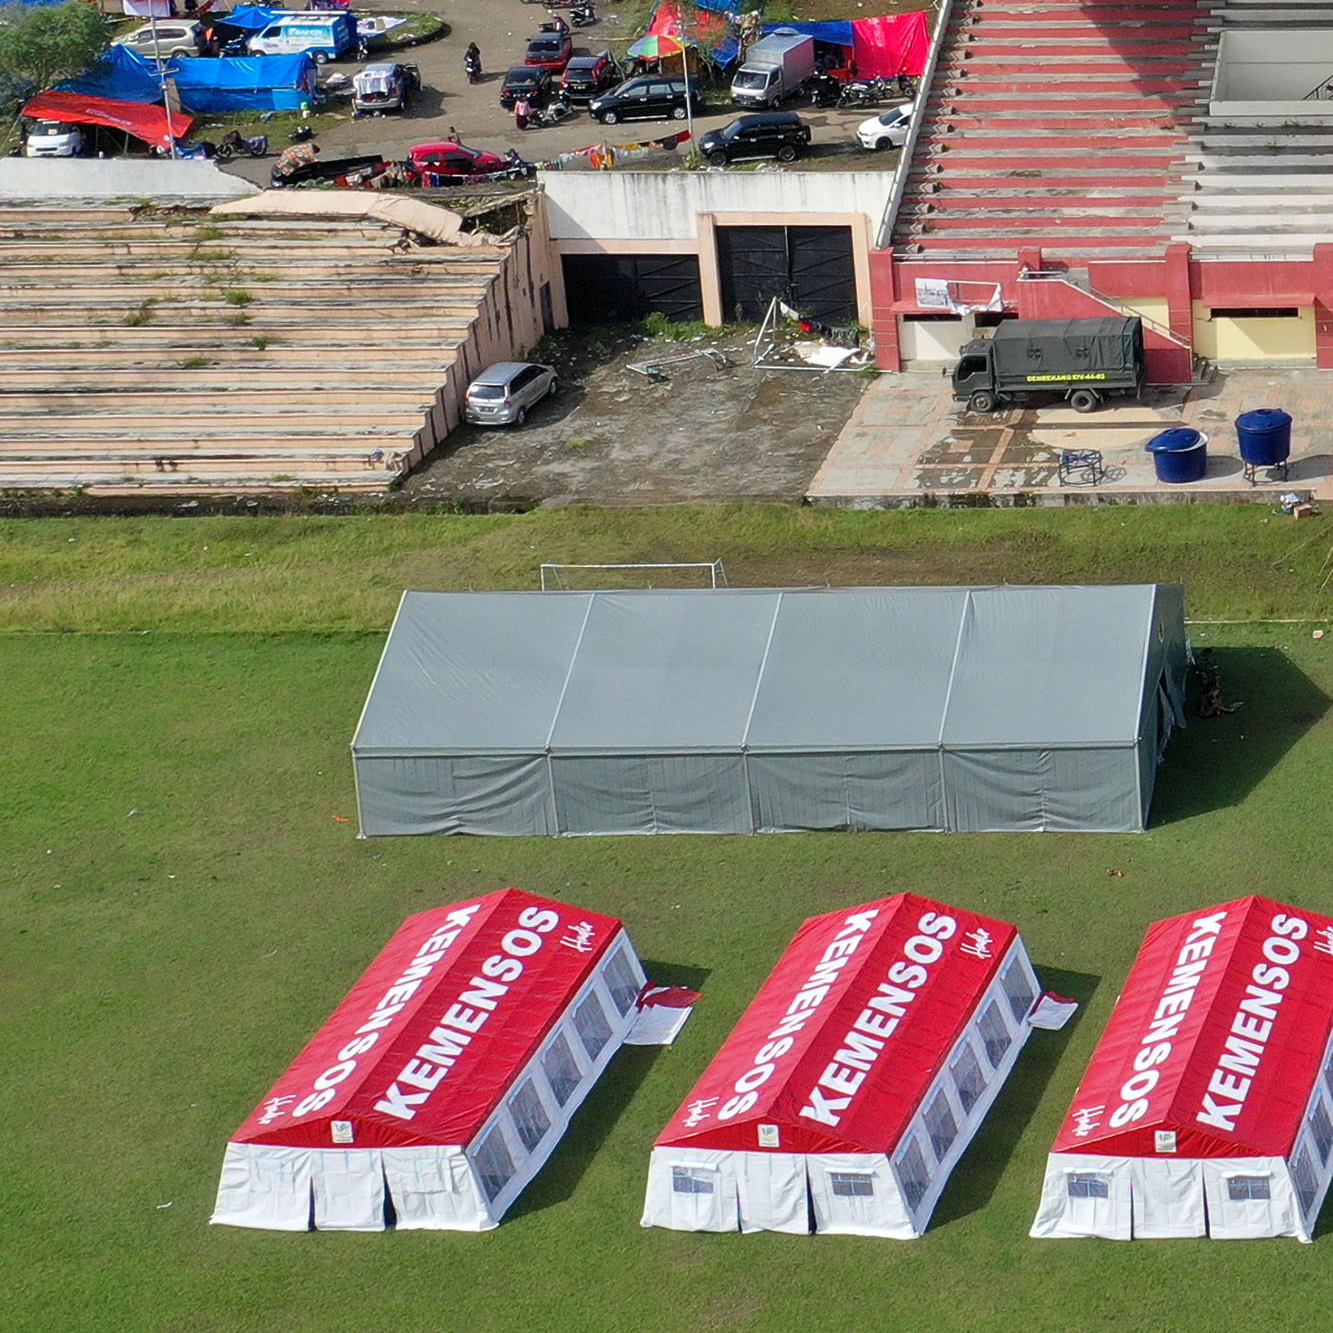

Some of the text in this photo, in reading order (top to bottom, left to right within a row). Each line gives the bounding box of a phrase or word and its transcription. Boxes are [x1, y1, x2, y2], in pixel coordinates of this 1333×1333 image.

[291, 904, 481, 1118] KEMENSOS
[373, 906, 559, 1120] KEMENSOS
[717, 908, 880, 1121] KEMENSOS
[799, 912, 957, 1127] KEMENSOS
[1108, 911, 1228, 1129] KEMENSOS
[1196, 914, 1308, 1132] KEMENSOS
